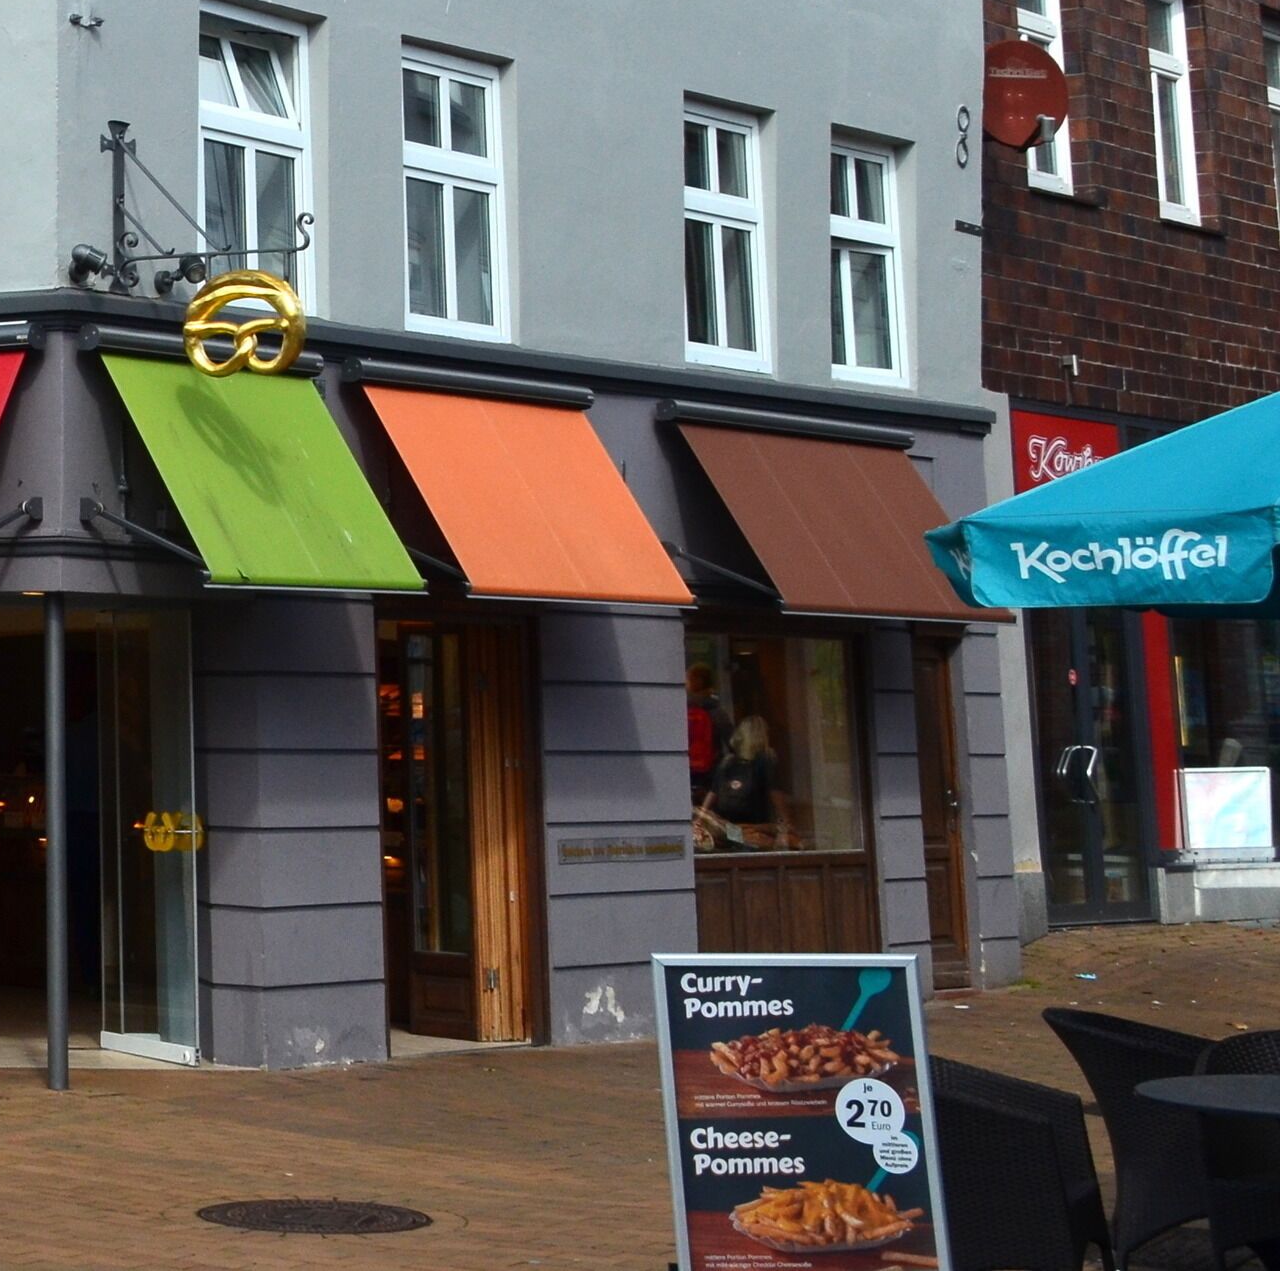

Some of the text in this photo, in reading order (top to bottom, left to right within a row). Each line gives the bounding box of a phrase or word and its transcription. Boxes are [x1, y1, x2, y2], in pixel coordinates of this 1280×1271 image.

[1010, 528, 1228, 584] Kochlöffel
[680, 972, 763, 996] Curry-
[683, 997, 794, 1019] Pommes
[863, 1083, 873, 1093] je
[690, 1126, 792, 1149] Cheese-
[871, 1121, 891, 1131] Euro
[693, 1153, 806, 1176] Pommes
